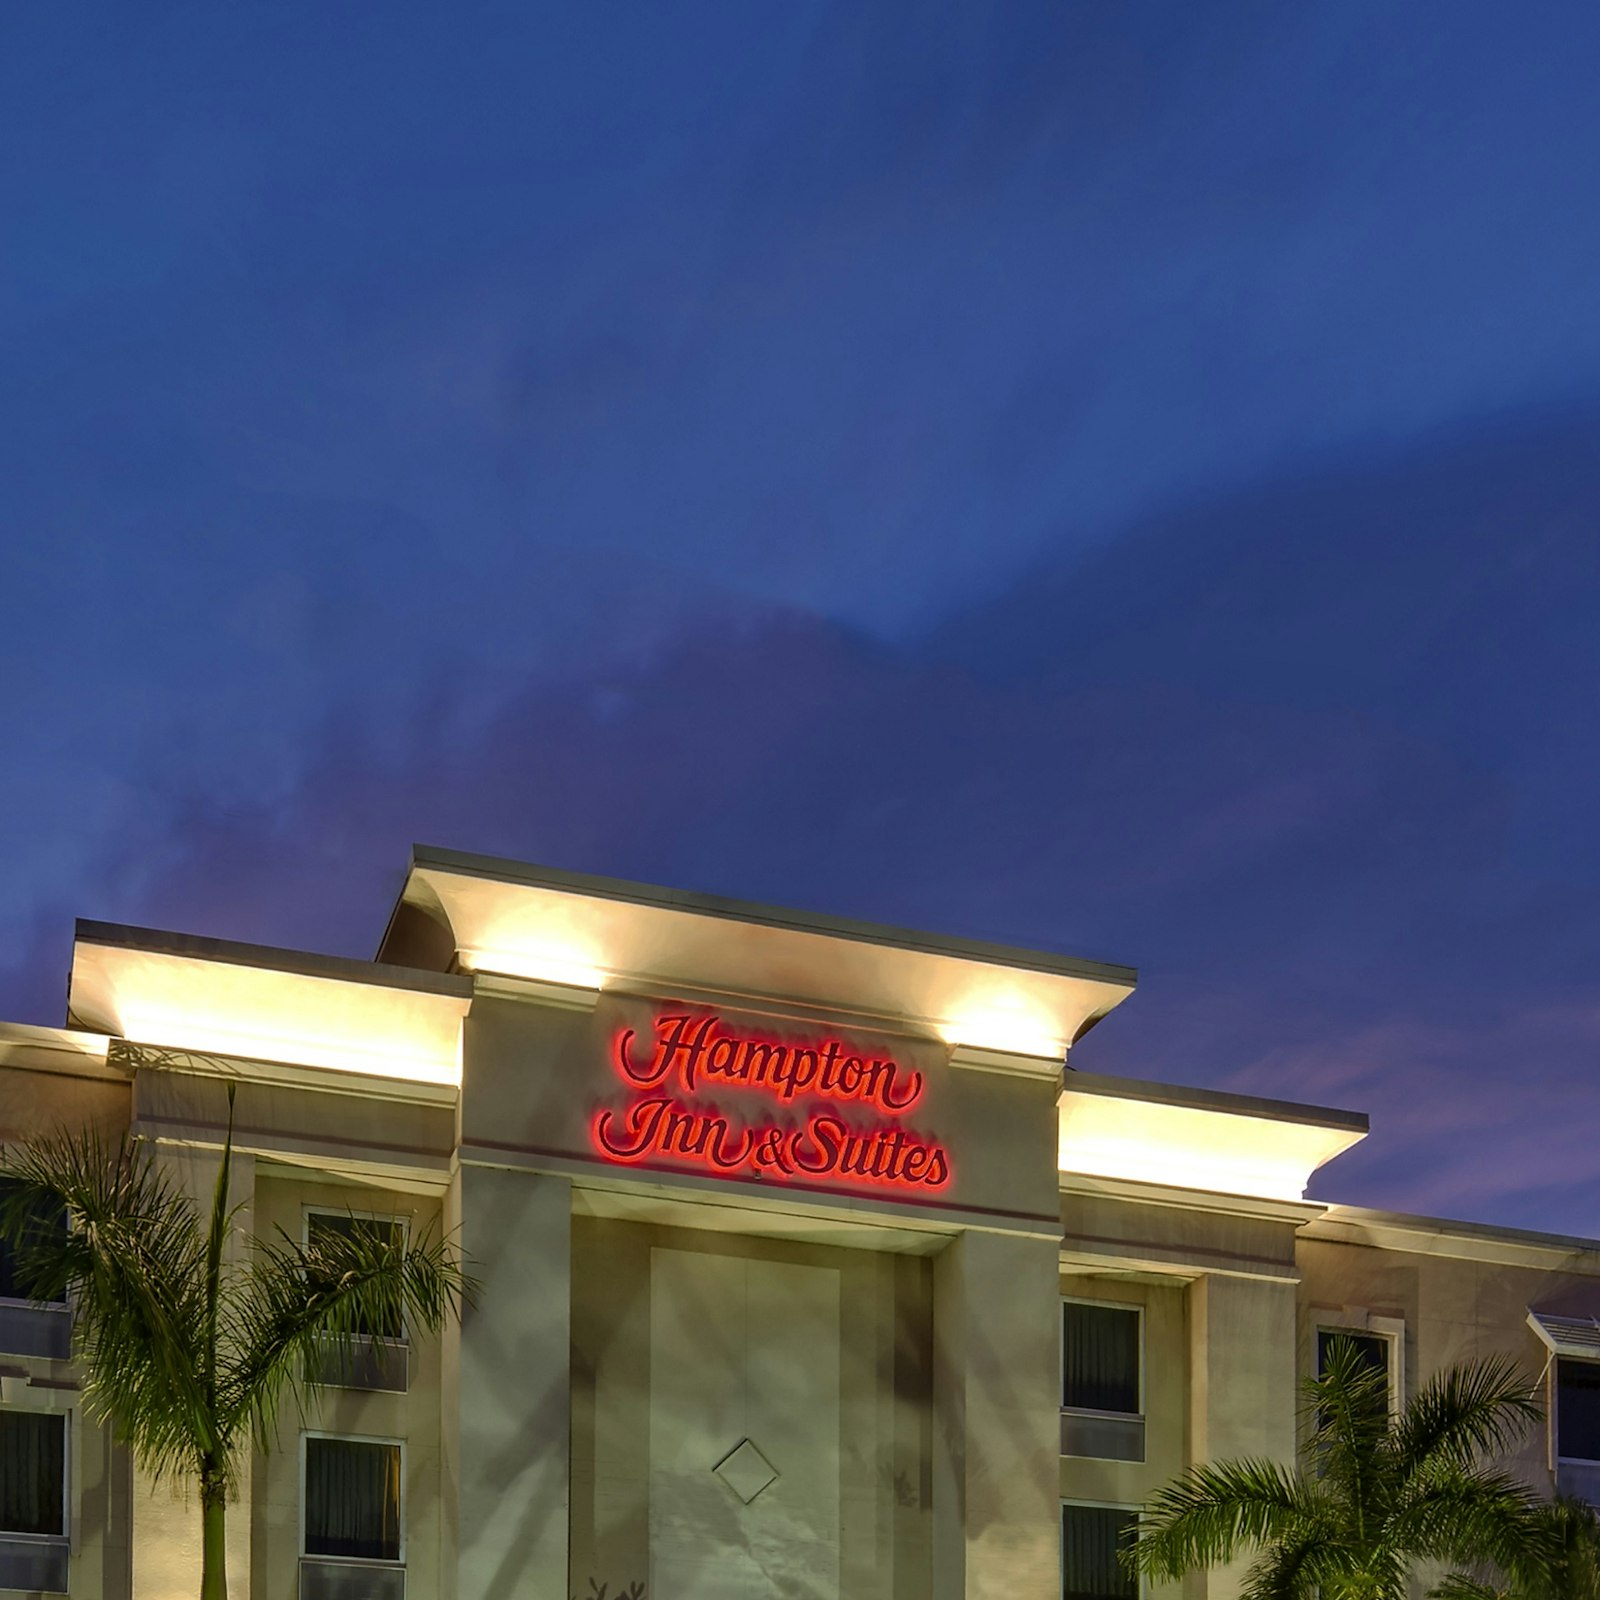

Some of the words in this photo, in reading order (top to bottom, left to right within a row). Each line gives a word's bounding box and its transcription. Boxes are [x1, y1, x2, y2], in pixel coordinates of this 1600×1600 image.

[620, 1016, 922, 1109] Hampton
[600, 1099, 754, 1168] Inn
[755, 1128, 794, 1174] &
[791, 1117, 949, 1186] Suites
